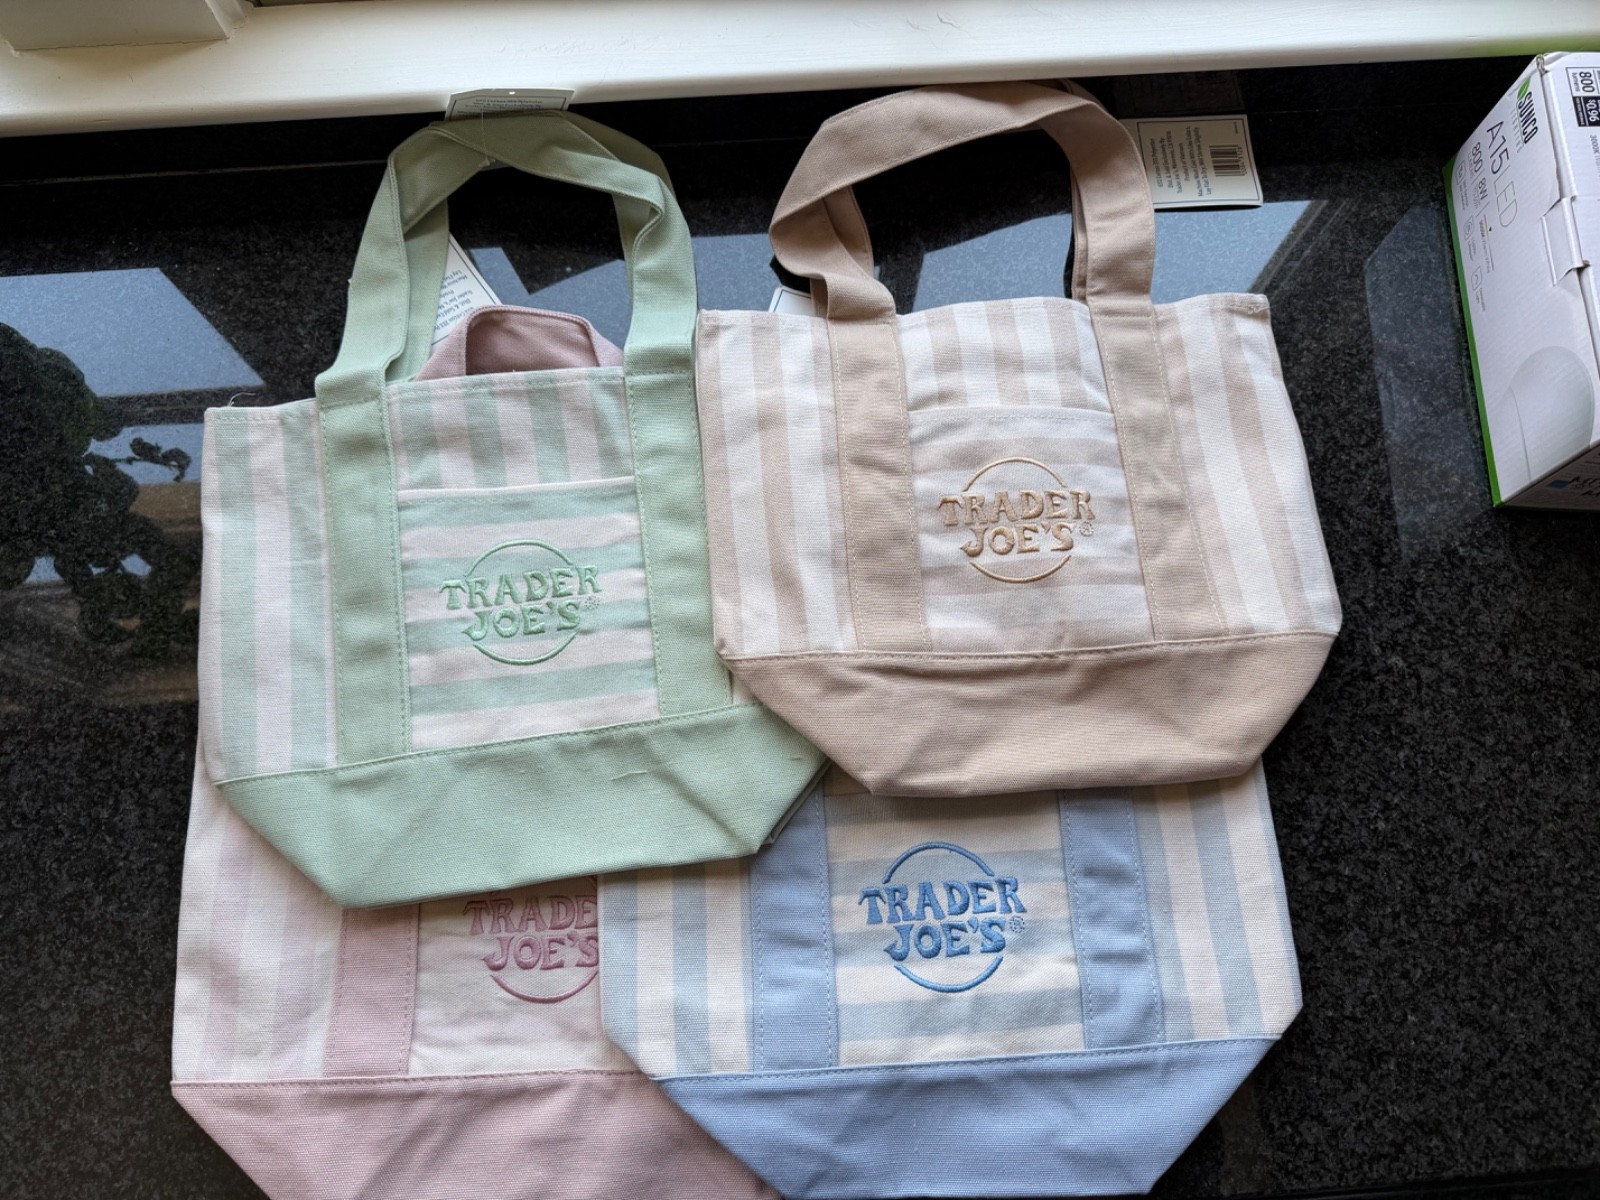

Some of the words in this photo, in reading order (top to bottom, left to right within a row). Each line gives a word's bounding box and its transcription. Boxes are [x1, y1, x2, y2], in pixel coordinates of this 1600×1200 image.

[1578, 71, 1596, 93] 800
[1517, 91, 1539, 145] SUNCO
[1585, 99, 1600, 122] $0.96
[1471, 141, 1483, 173] 800
[1486, 121, 1510, 175] A15
[1478, 177, 1489, 200] 8W
[1493, 164, 1518, 228] LED
[937, 489, 1096, 526] TRADER
[439, 564, 602, 610] TRADER
[462, 894, 597, 936] TRADE
[858, 876, 1027, 925] TRADER
